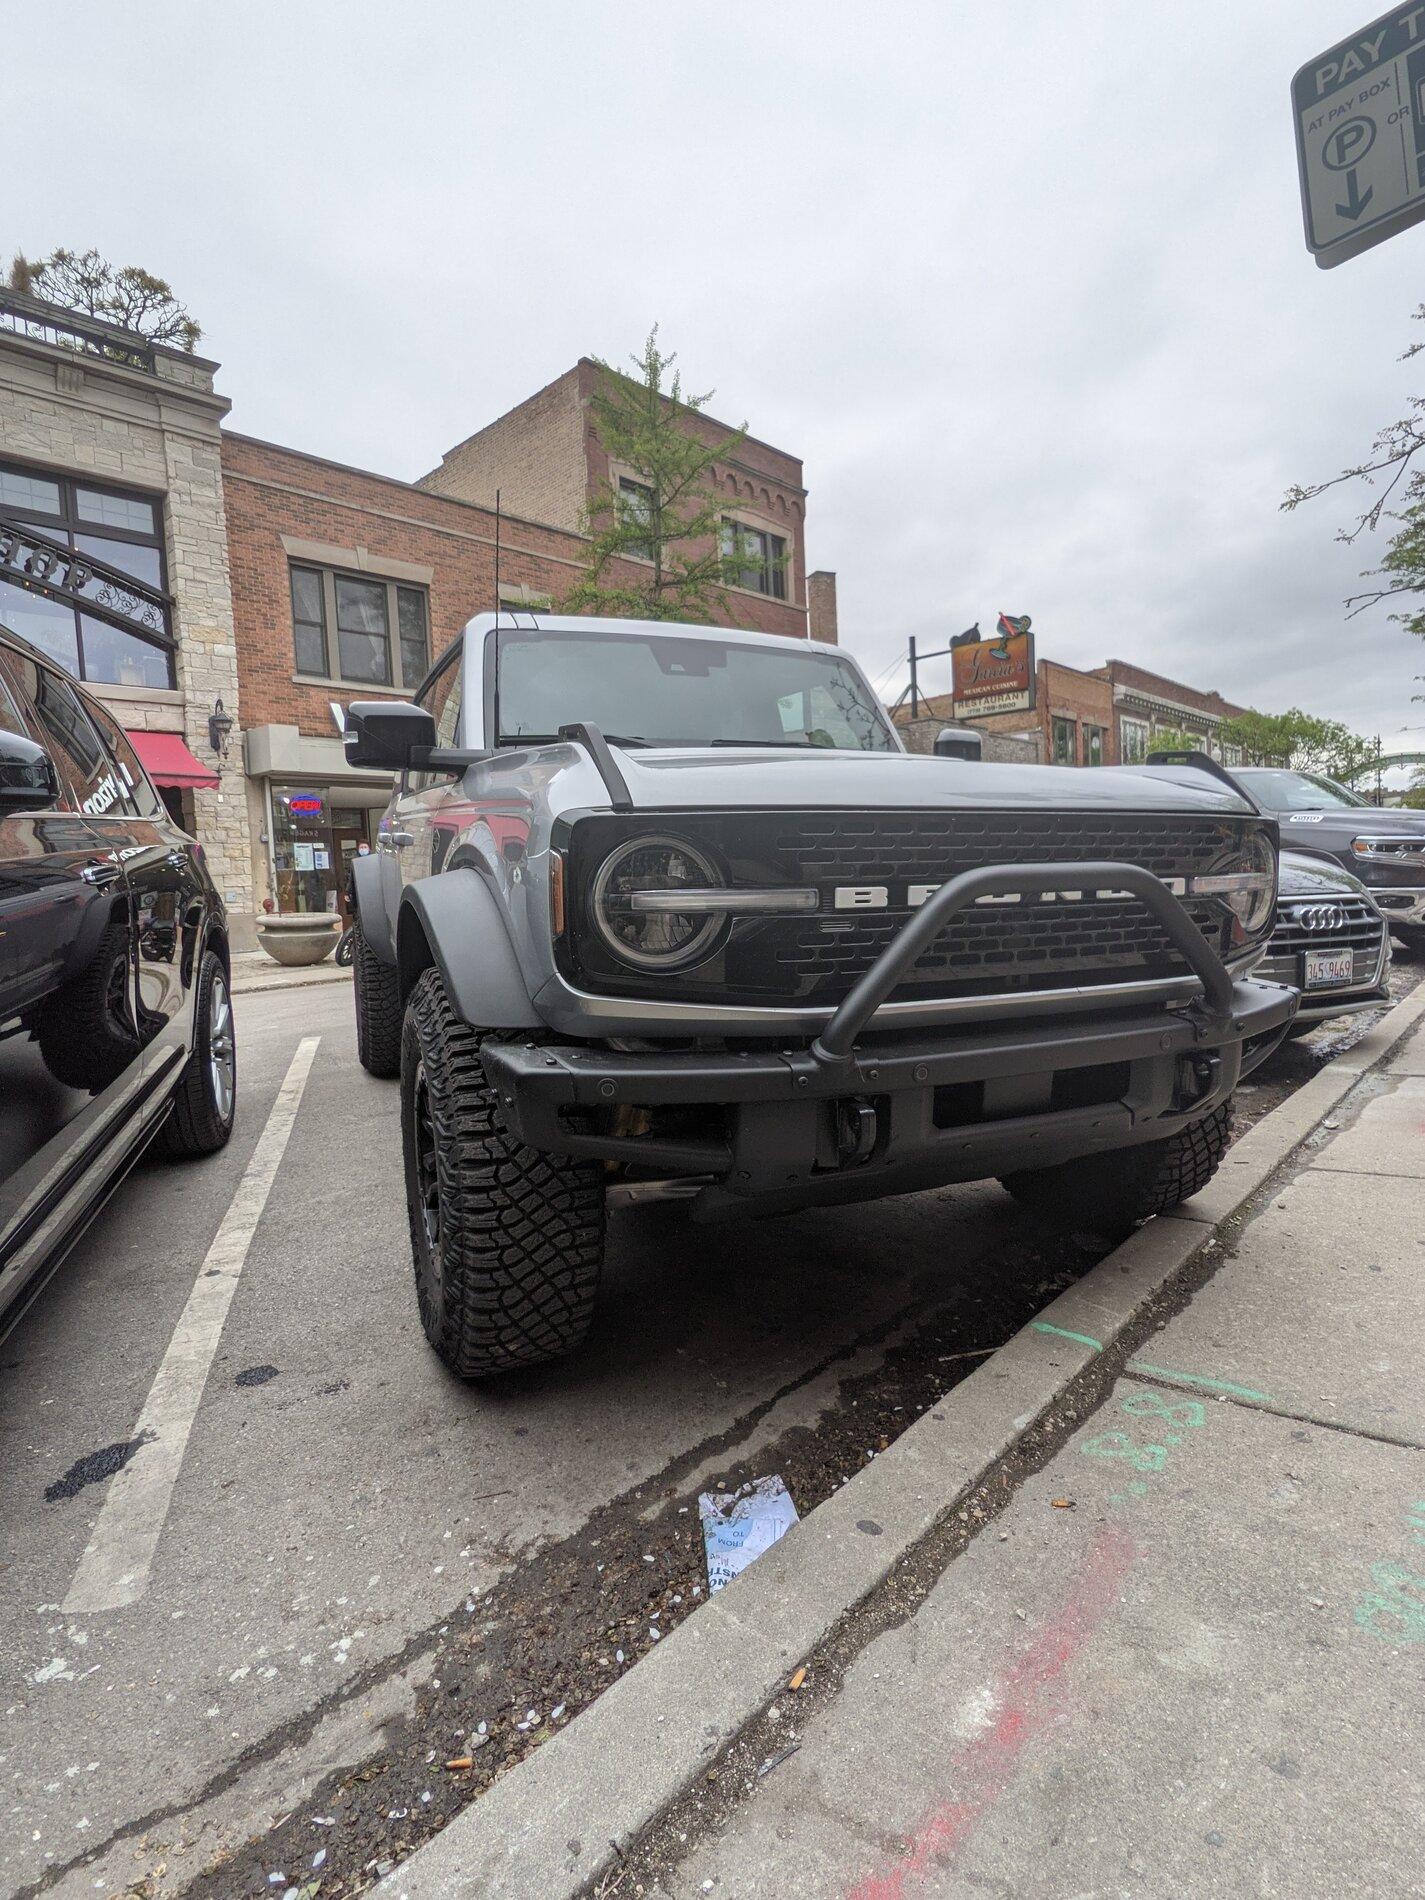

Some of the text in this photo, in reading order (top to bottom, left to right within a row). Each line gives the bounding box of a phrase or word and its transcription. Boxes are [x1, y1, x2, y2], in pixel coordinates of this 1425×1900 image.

[1315, 29, 1387, 96] PAY
[1307, 76, 1391, 134] AT PAY BOX
[1387, 105, 1410, 125] OR
[1334, 124, 1365, 164] P
[963, 681, 1018, 696] MEXICAN CUISINE
[957, 691, 1026, 709] RESTAURANT
[717, 1538, 744, 1548] FROM
[732, 1530, 745, 1538] TO
